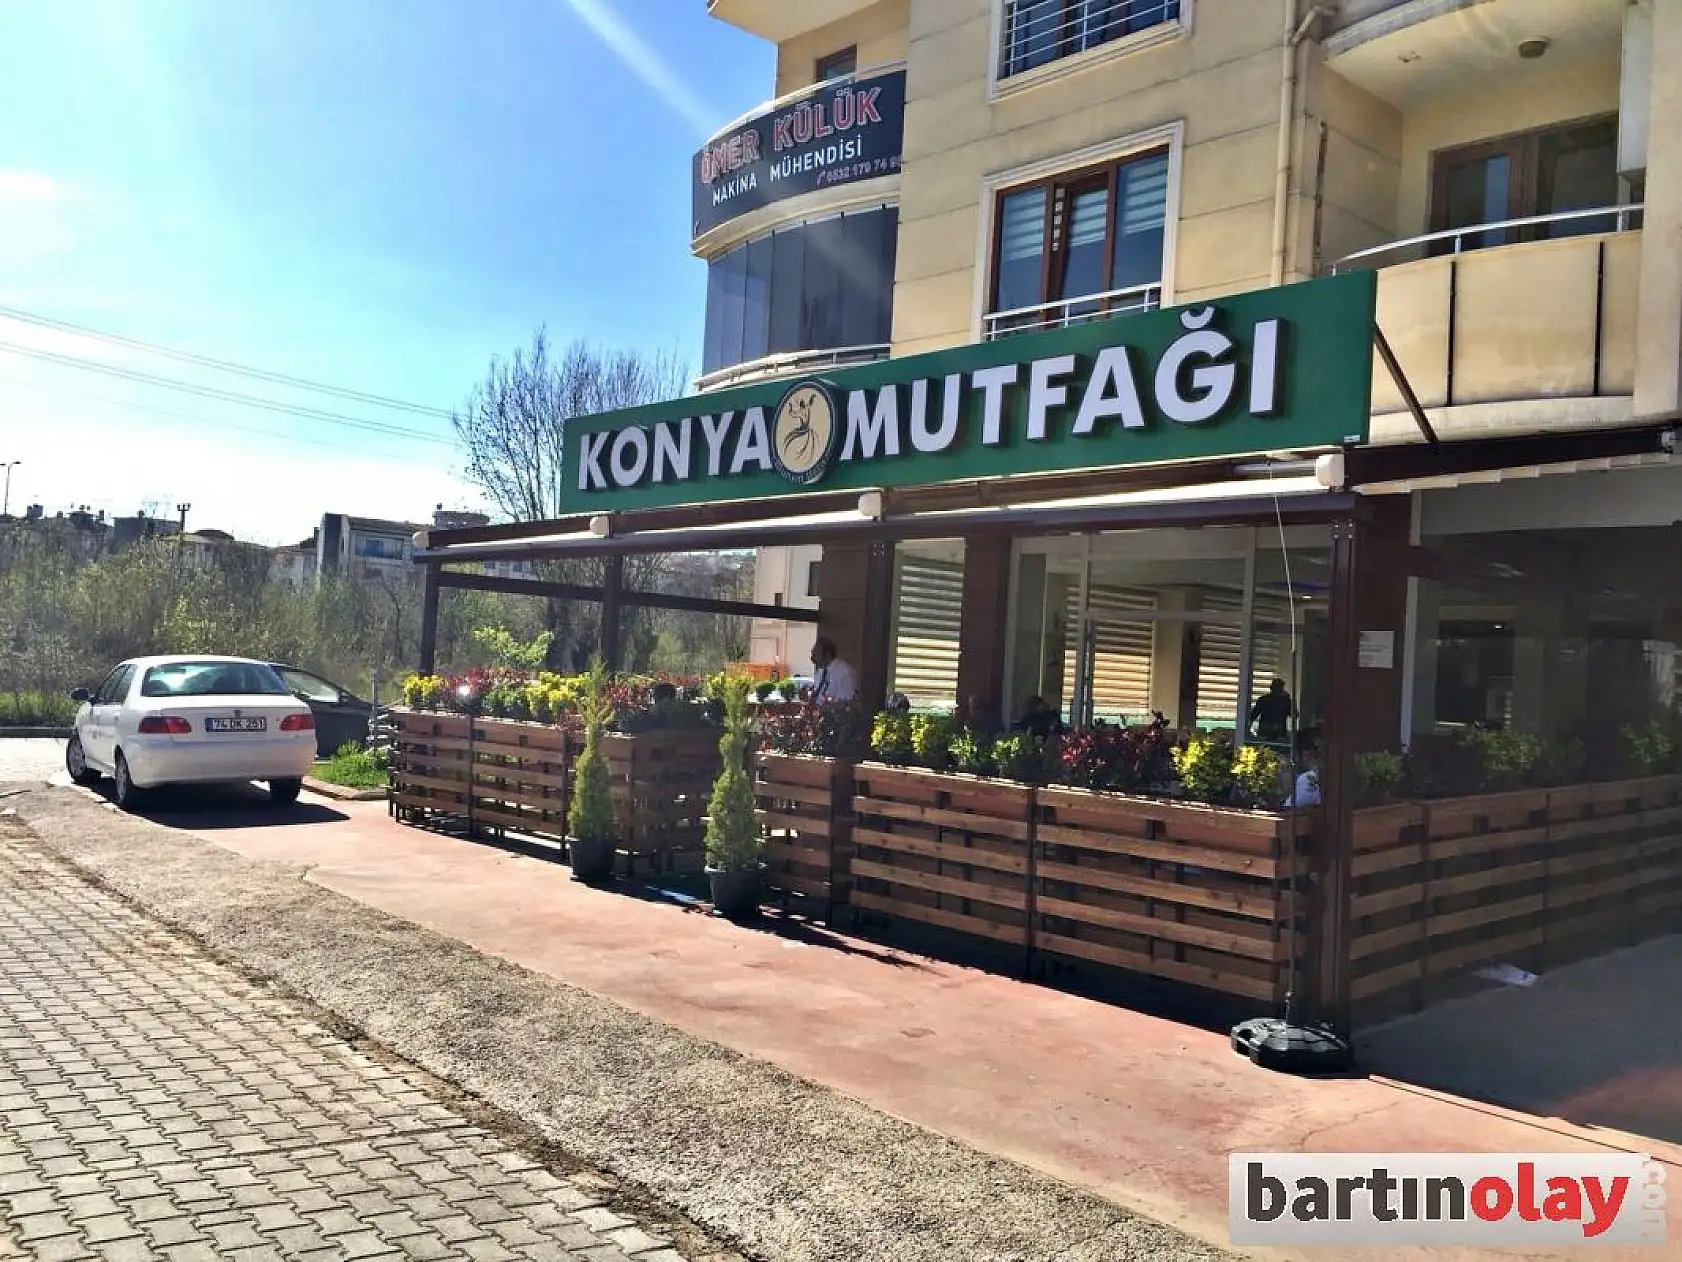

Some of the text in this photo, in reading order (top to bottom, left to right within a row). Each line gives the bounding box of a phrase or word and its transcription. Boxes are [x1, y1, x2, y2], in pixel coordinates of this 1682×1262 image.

[772, 86, 883, 152] KÜLÜK
[712, 133, 862, 206] MAKİNA MÜHENDİSİ
[578, 305, 1279, 491] KONYA MUTFAĞI
